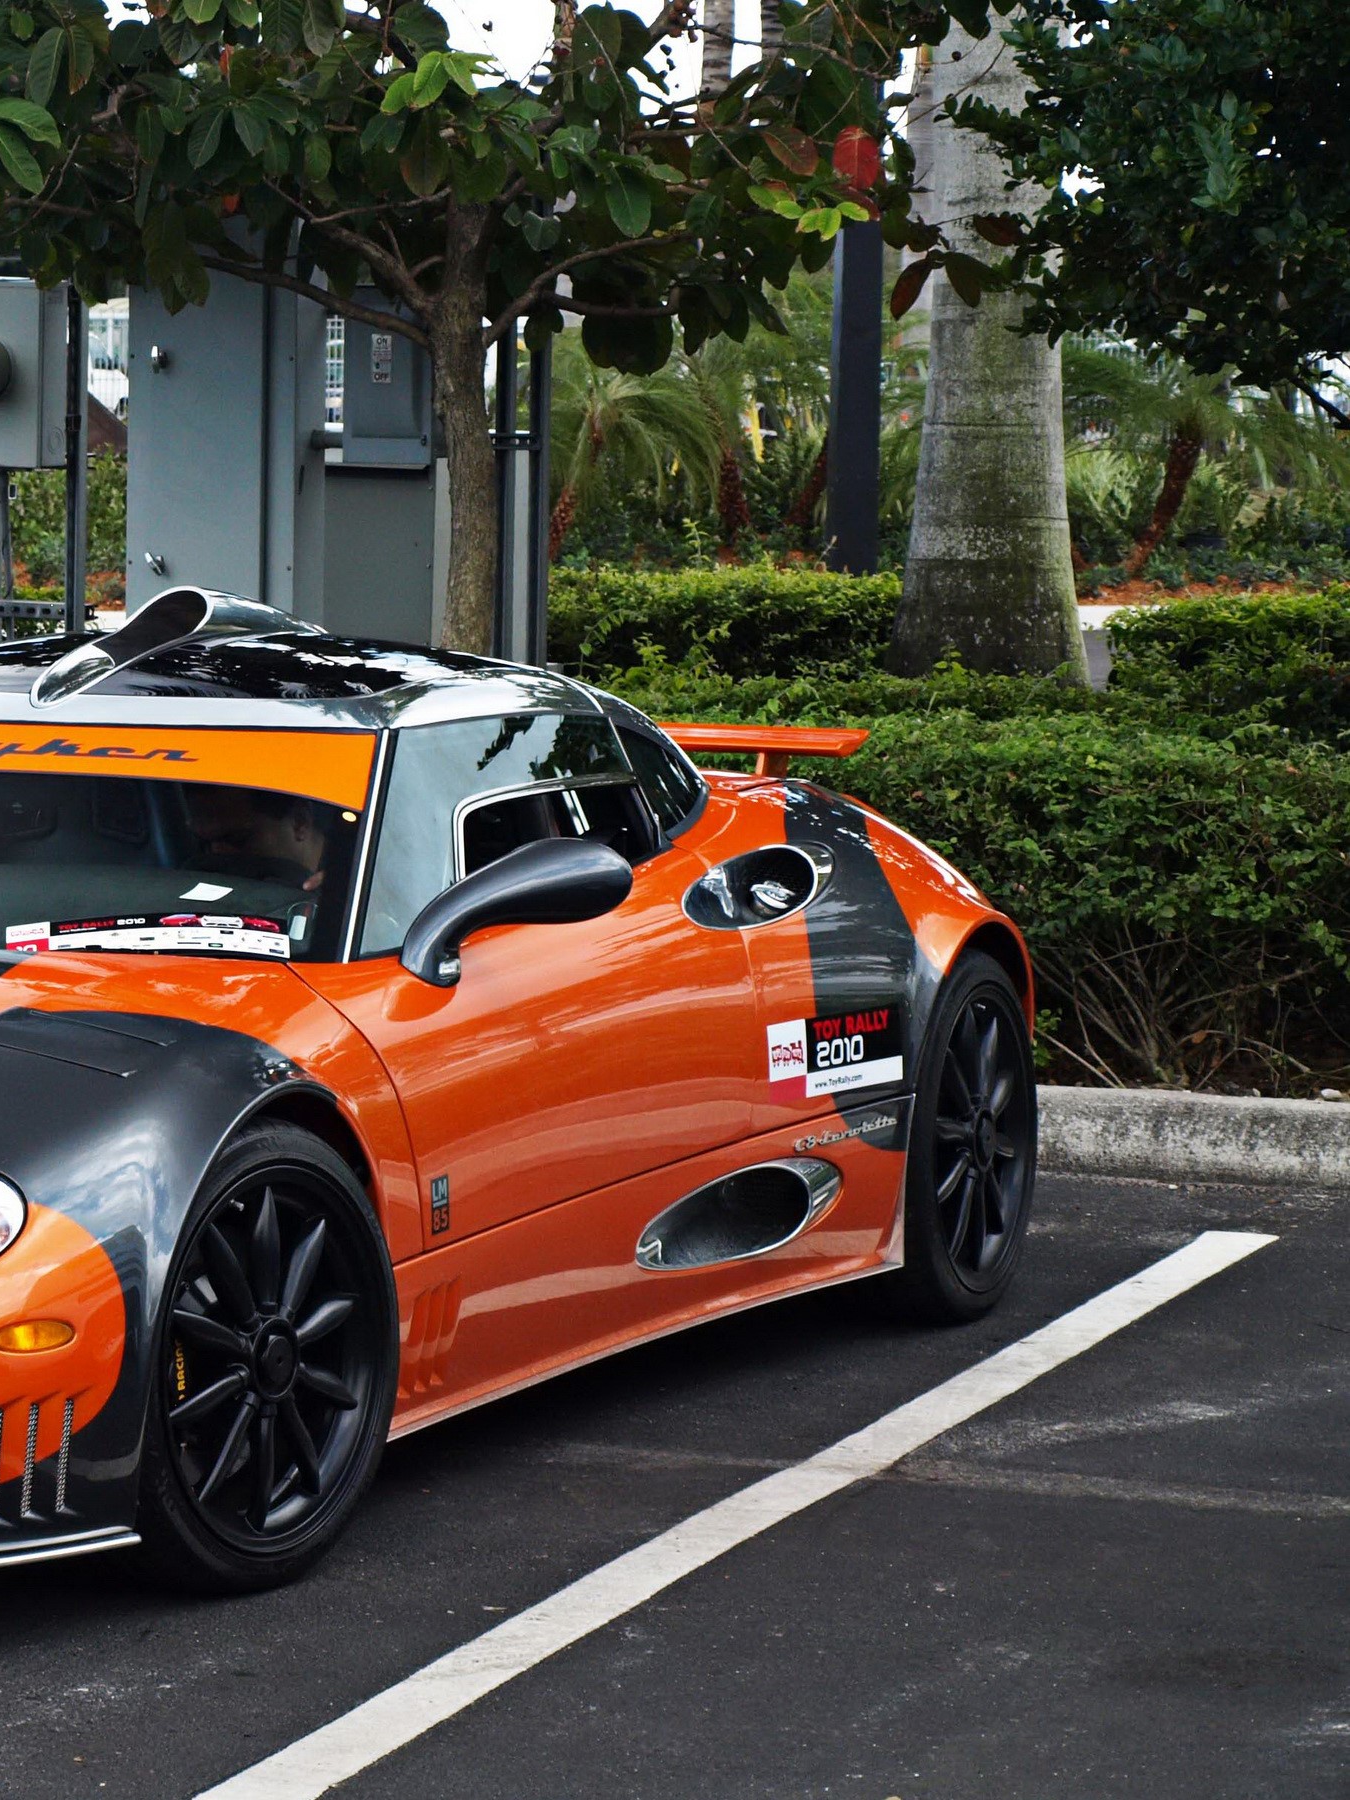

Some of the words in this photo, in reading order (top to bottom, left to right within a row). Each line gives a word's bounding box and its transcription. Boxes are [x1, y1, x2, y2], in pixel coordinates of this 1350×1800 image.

[376, 337, 388, 346] ON
[374, 372, 389, 381] OFF
[82, 919, 115, 928] RALLY
[116, 917, 146, 926] 2010
[812, 1017, 842, 1040] TOY
[845, 1009, 889, 1035] RALLY
[816, 1034, 864, 1068] 2010
[432, 1178, 448, 1202] LM
[433, 1205, 448, 1231] 85
